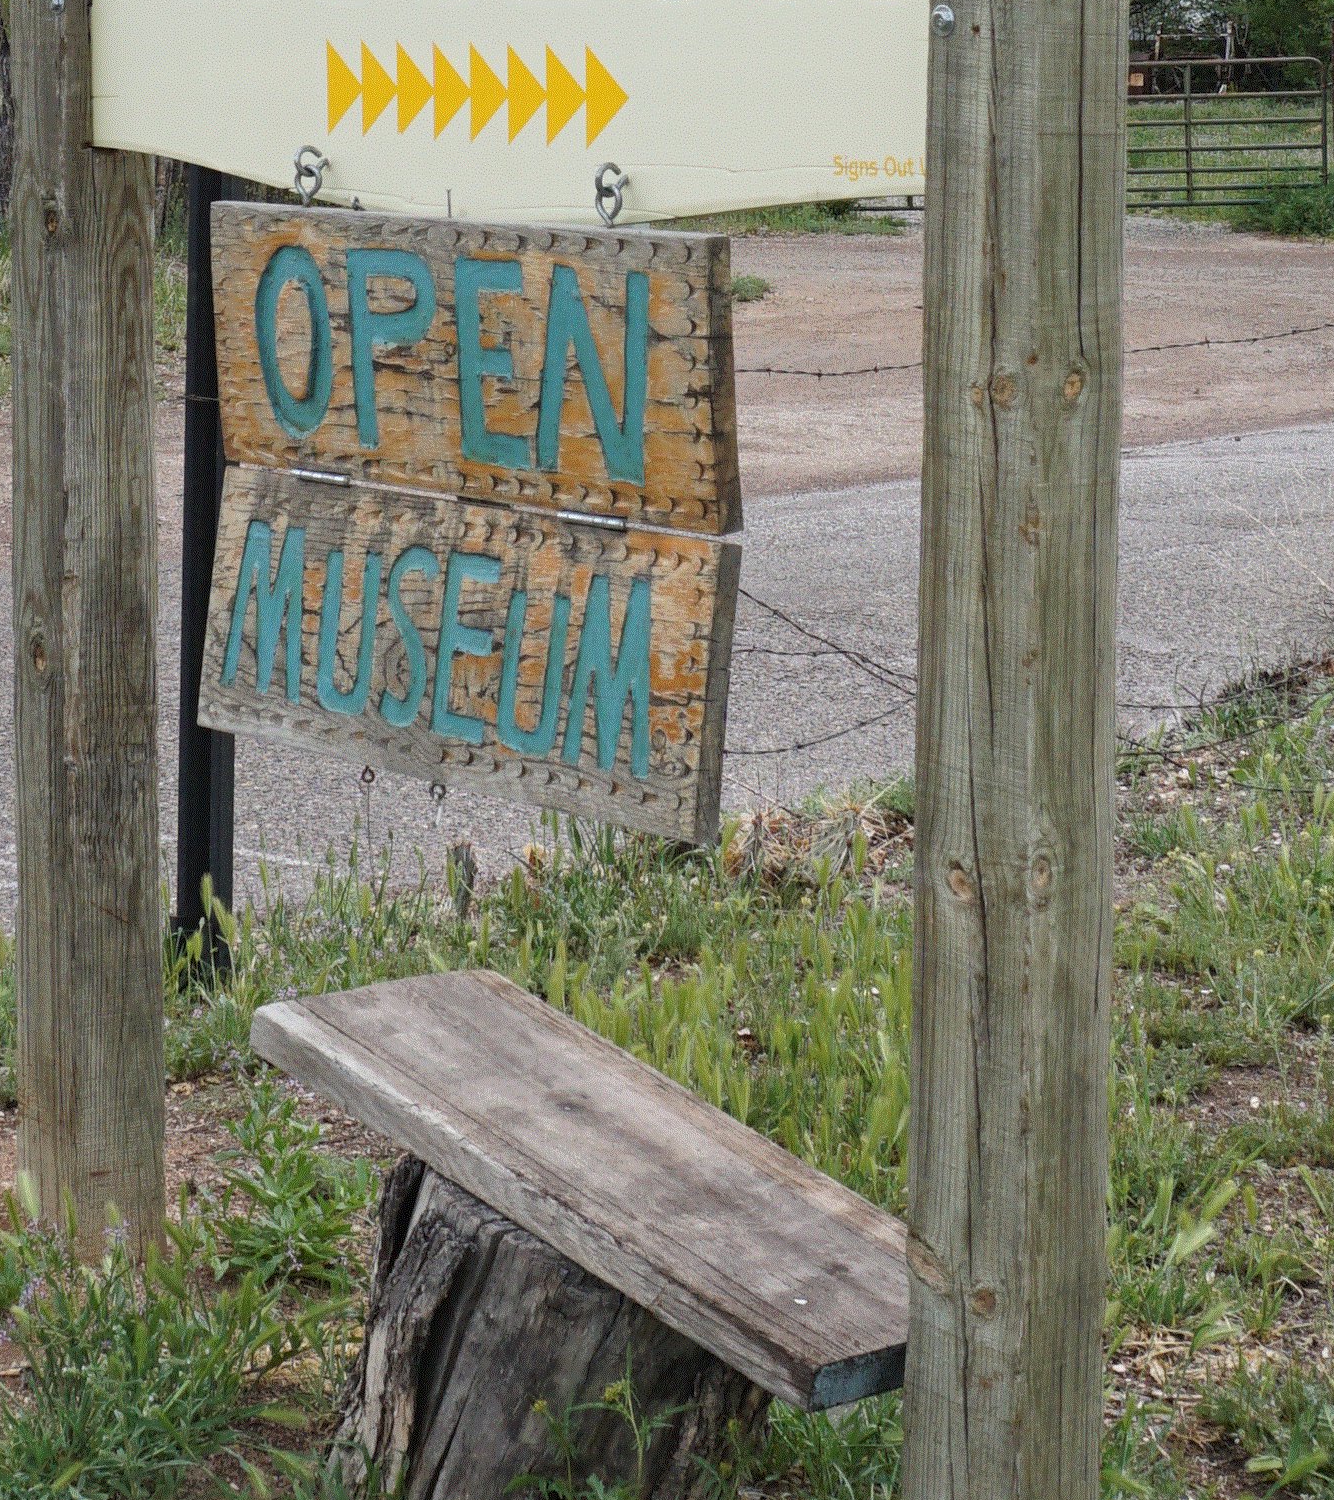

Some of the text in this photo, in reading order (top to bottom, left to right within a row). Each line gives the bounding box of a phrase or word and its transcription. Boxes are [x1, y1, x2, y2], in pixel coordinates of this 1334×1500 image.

[832, 153, 878, 182] Signs
[883, 155, 914, 178] Out
[254, 245, 650, 488] OPEN
[220, 519, 651, 780] MUSEUM
